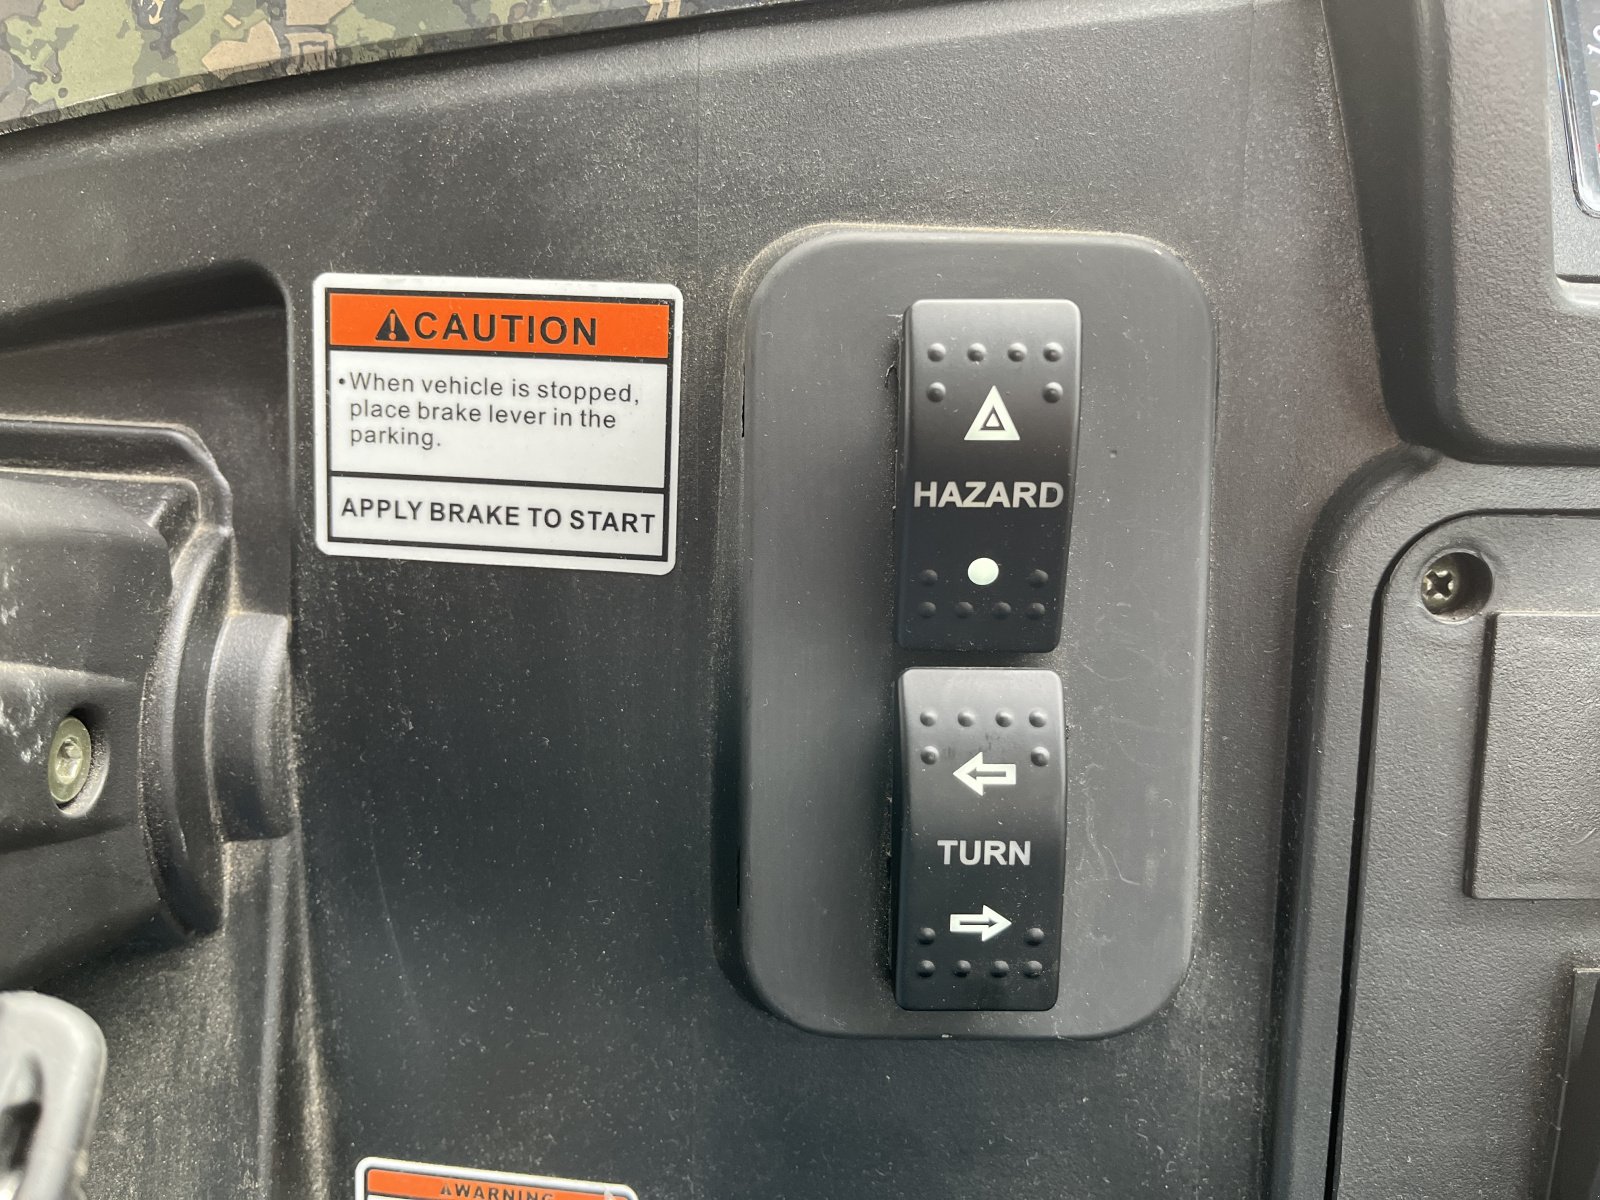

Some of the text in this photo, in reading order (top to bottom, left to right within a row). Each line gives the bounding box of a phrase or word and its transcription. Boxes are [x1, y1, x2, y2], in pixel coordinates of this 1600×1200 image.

[414, 311, 597, 346] CAUTION
[349, 371, 639, 405] When vehicle is stopped,
[350, 399, 617, 429] place brake lever in the
[350, 426, 442, 451] parking.
[913, 480, 1064, 509] HAZARD
[341, 498, 656, 535] APPLY BRAKE TO START
[936, 839, 1032, 866] TURN
